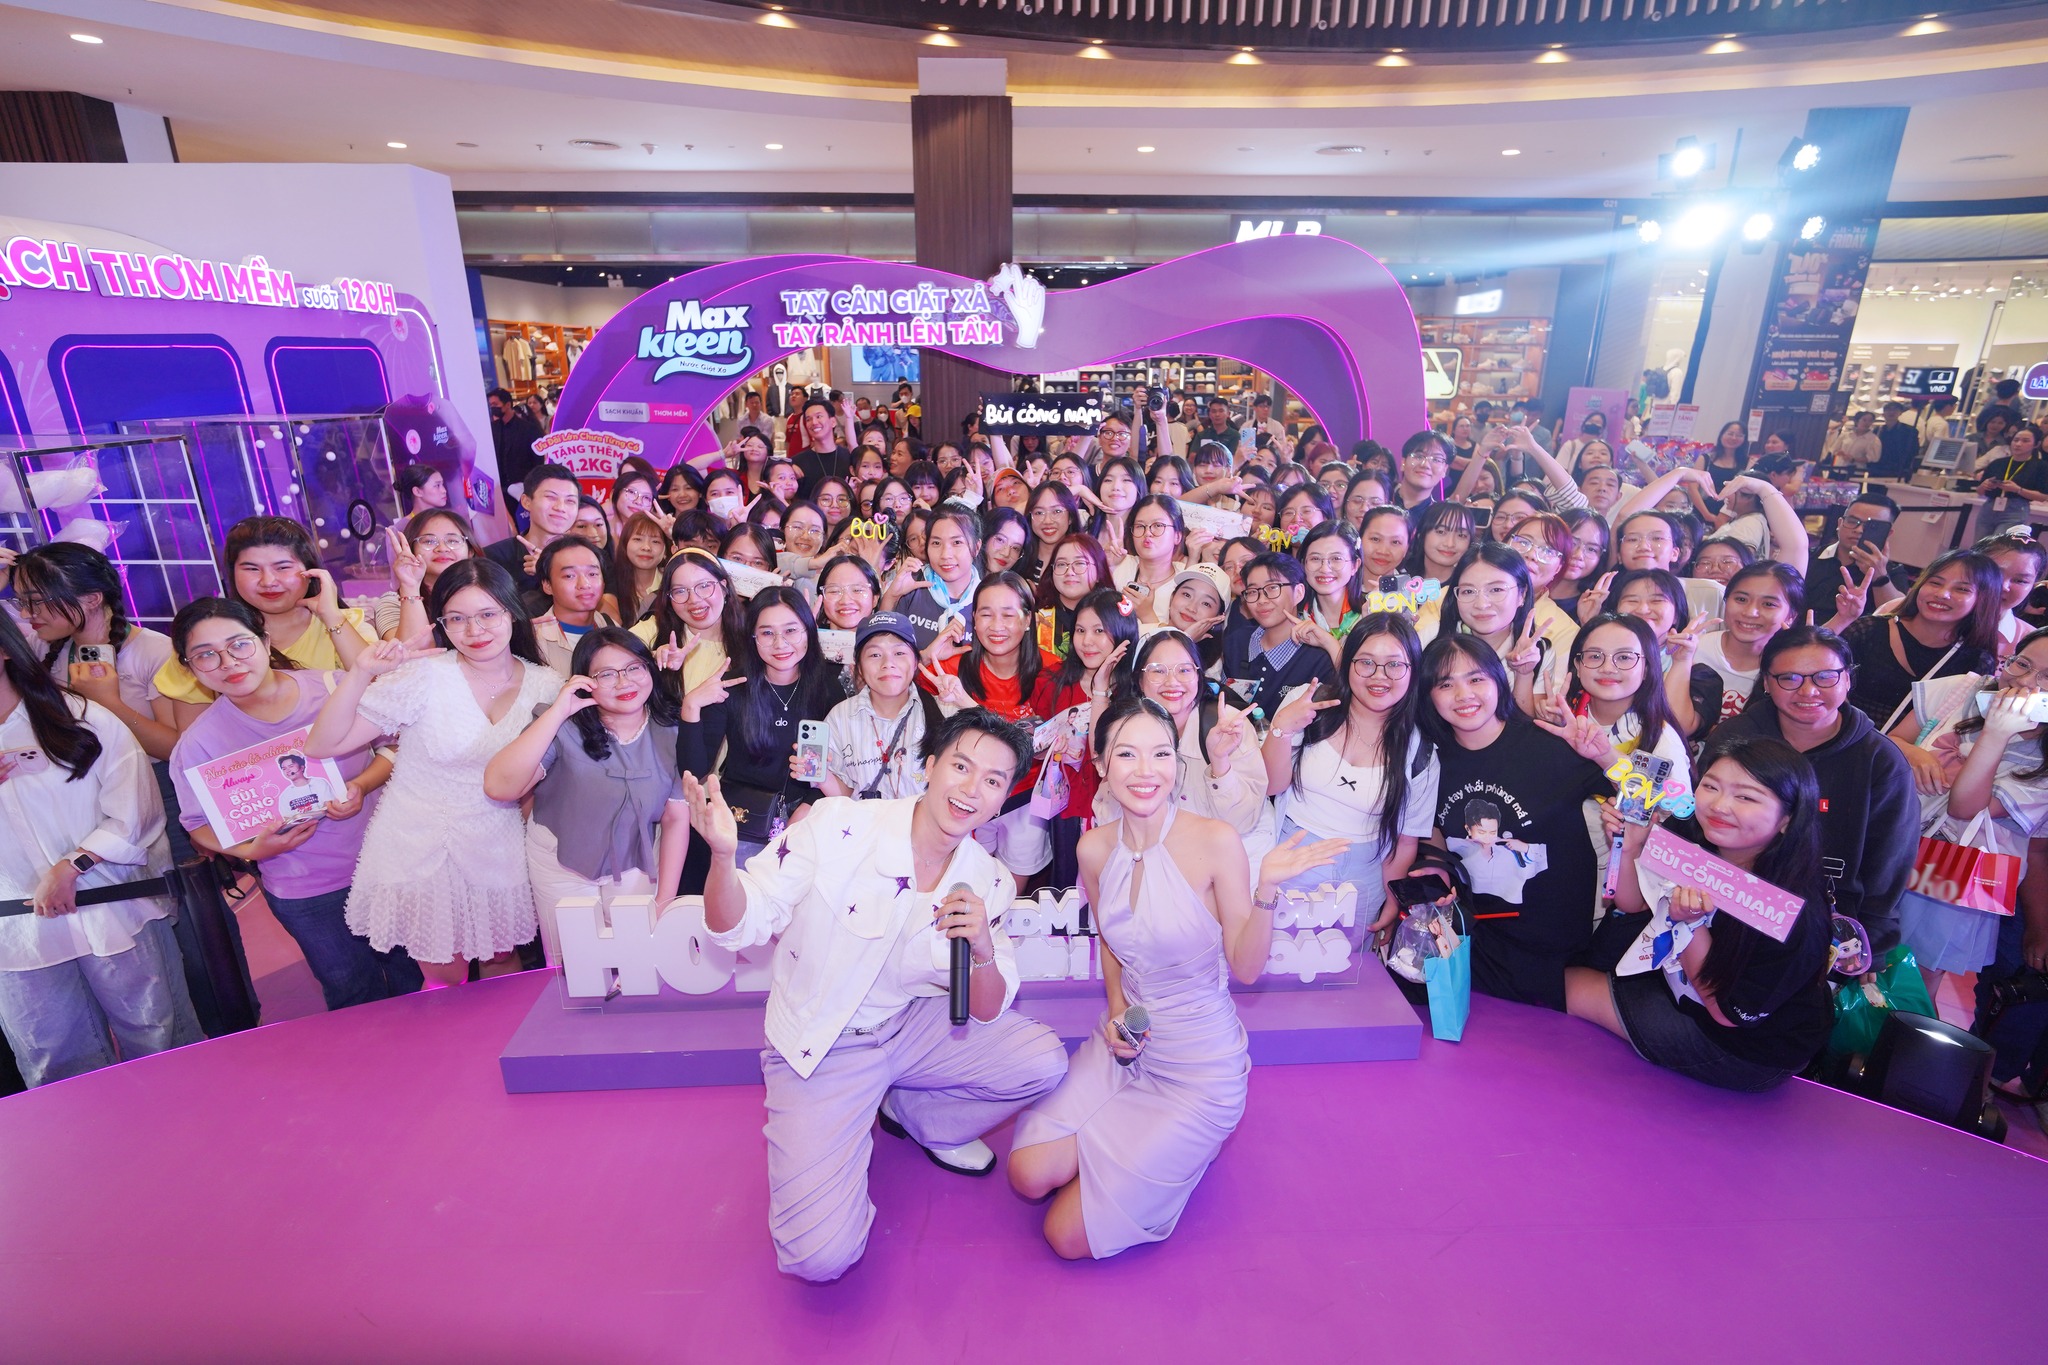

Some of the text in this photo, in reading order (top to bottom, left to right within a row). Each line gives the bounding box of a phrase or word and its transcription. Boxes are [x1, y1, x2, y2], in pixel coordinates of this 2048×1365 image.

[87, 248, 222, 301] THƠM
[220, 255, 299, 308] MỀM
[302, 284, 339, 310] SUỐT
[339, 277, 398, 316] 120H
[780, 283, 991, 320] TAY CÂN GIẶT XẢ
[665, 300, 750, 332] Max
[773, 312, 1002, 348] TAY RẢNH LÊN TẦM
[637, 326, 746, 359] kleen
[1929, 385, 1947, 393] VND
[1016, 403, 1061, 424] CÔNG
[1064, 406, 1102, 425] NAM
[552, 444, 624, 461] TẶNG THÊM
[562, 431, 579, 443] Lớn
[579, 431, 603, 443] Chưa
[626, 439, 640, 452] Có
[566, 458, 613, 473] 1.2KG
[775, 718, 789, 727] alo
[222, 772, 255, 790] Always
[1448, 789, 1464, 804] tay
[1464, 779, 1484, 794] thổi
[1485, 783, 1516, 804] phùng
[229, 787, 259, 807] BÙI
[229, 796, 275, 820] CÔNG
[237, 810, 274, 831] NAM
[1650, 845, 1681, 869] BÙI
[1681, 864, 1735, 899] CÔNG
[1735, 890, 1786, 926] NAM
